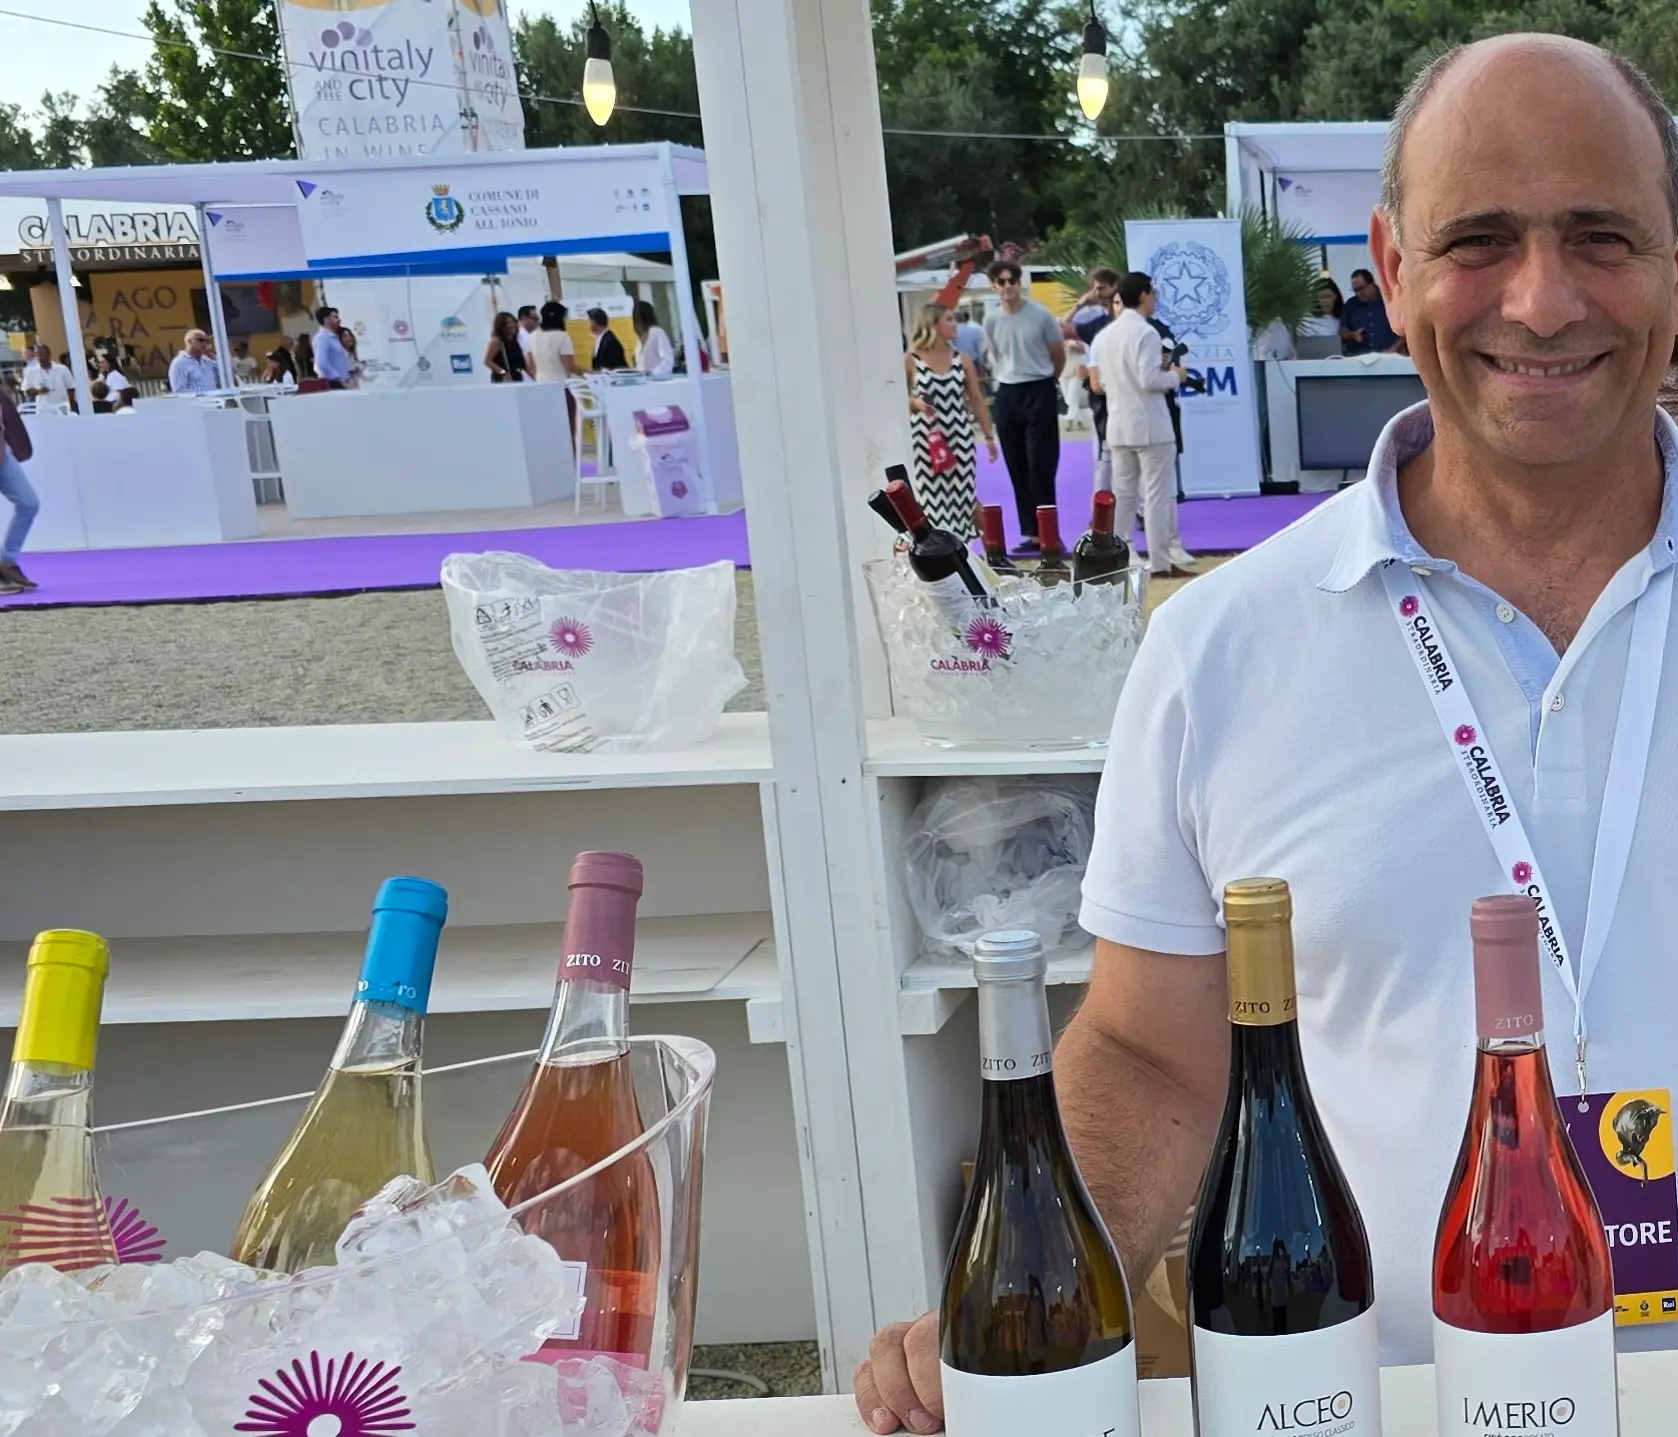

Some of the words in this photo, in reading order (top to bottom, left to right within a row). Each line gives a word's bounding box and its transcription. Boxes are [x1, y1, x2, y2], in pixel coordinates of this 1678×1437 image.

[309, 39, 434, 78] vinitaly
[314, 80, 343, 91] AND
[316, 91, 343, 101] THE
[349, 74, 410, 107] city
[318, 113, 446, 136] CALABRIA
[469, 190, 522, 201] COMUNE
[526, 189, 540, 200] DI
[470, 204, 527, 216] CASSANO
[22, 247, 200, 264] STORDINARIA
[112, 286, 177, 311] AGO
[1179, 366, 1238, 397] DM
[930, 659, 992, 671] CALABRIA
[1406, 621, 1441, 695] STRAORDINARIA
[1414, 616, 1453, 691] CALABRIA
[1461, 751, 1497, 829] STRAORDINARIA
[1470, 746, 1511, 825] CALABRIA
[1528, 884, 1564, 967] CALABRIA
[566, 954, 601, 968] ZITO
[612, 958, 631, 975] ZIT
[1234, 1001, 1271, 1014] ZITO
[1495, 1014, 1535, 1030] ZITO
[982, 1057, 1017, 1072] ZITO
[1031, 1051, 1051, 1067] ZIT
[1606, 1221, 1673, 1248] TORE
[1256, 1390, 1353, 1430] ALCEO
[1462, 1397, 1576, 1429] IMERIO
[1324, 1420, 1356, 1437] CLASSICO
